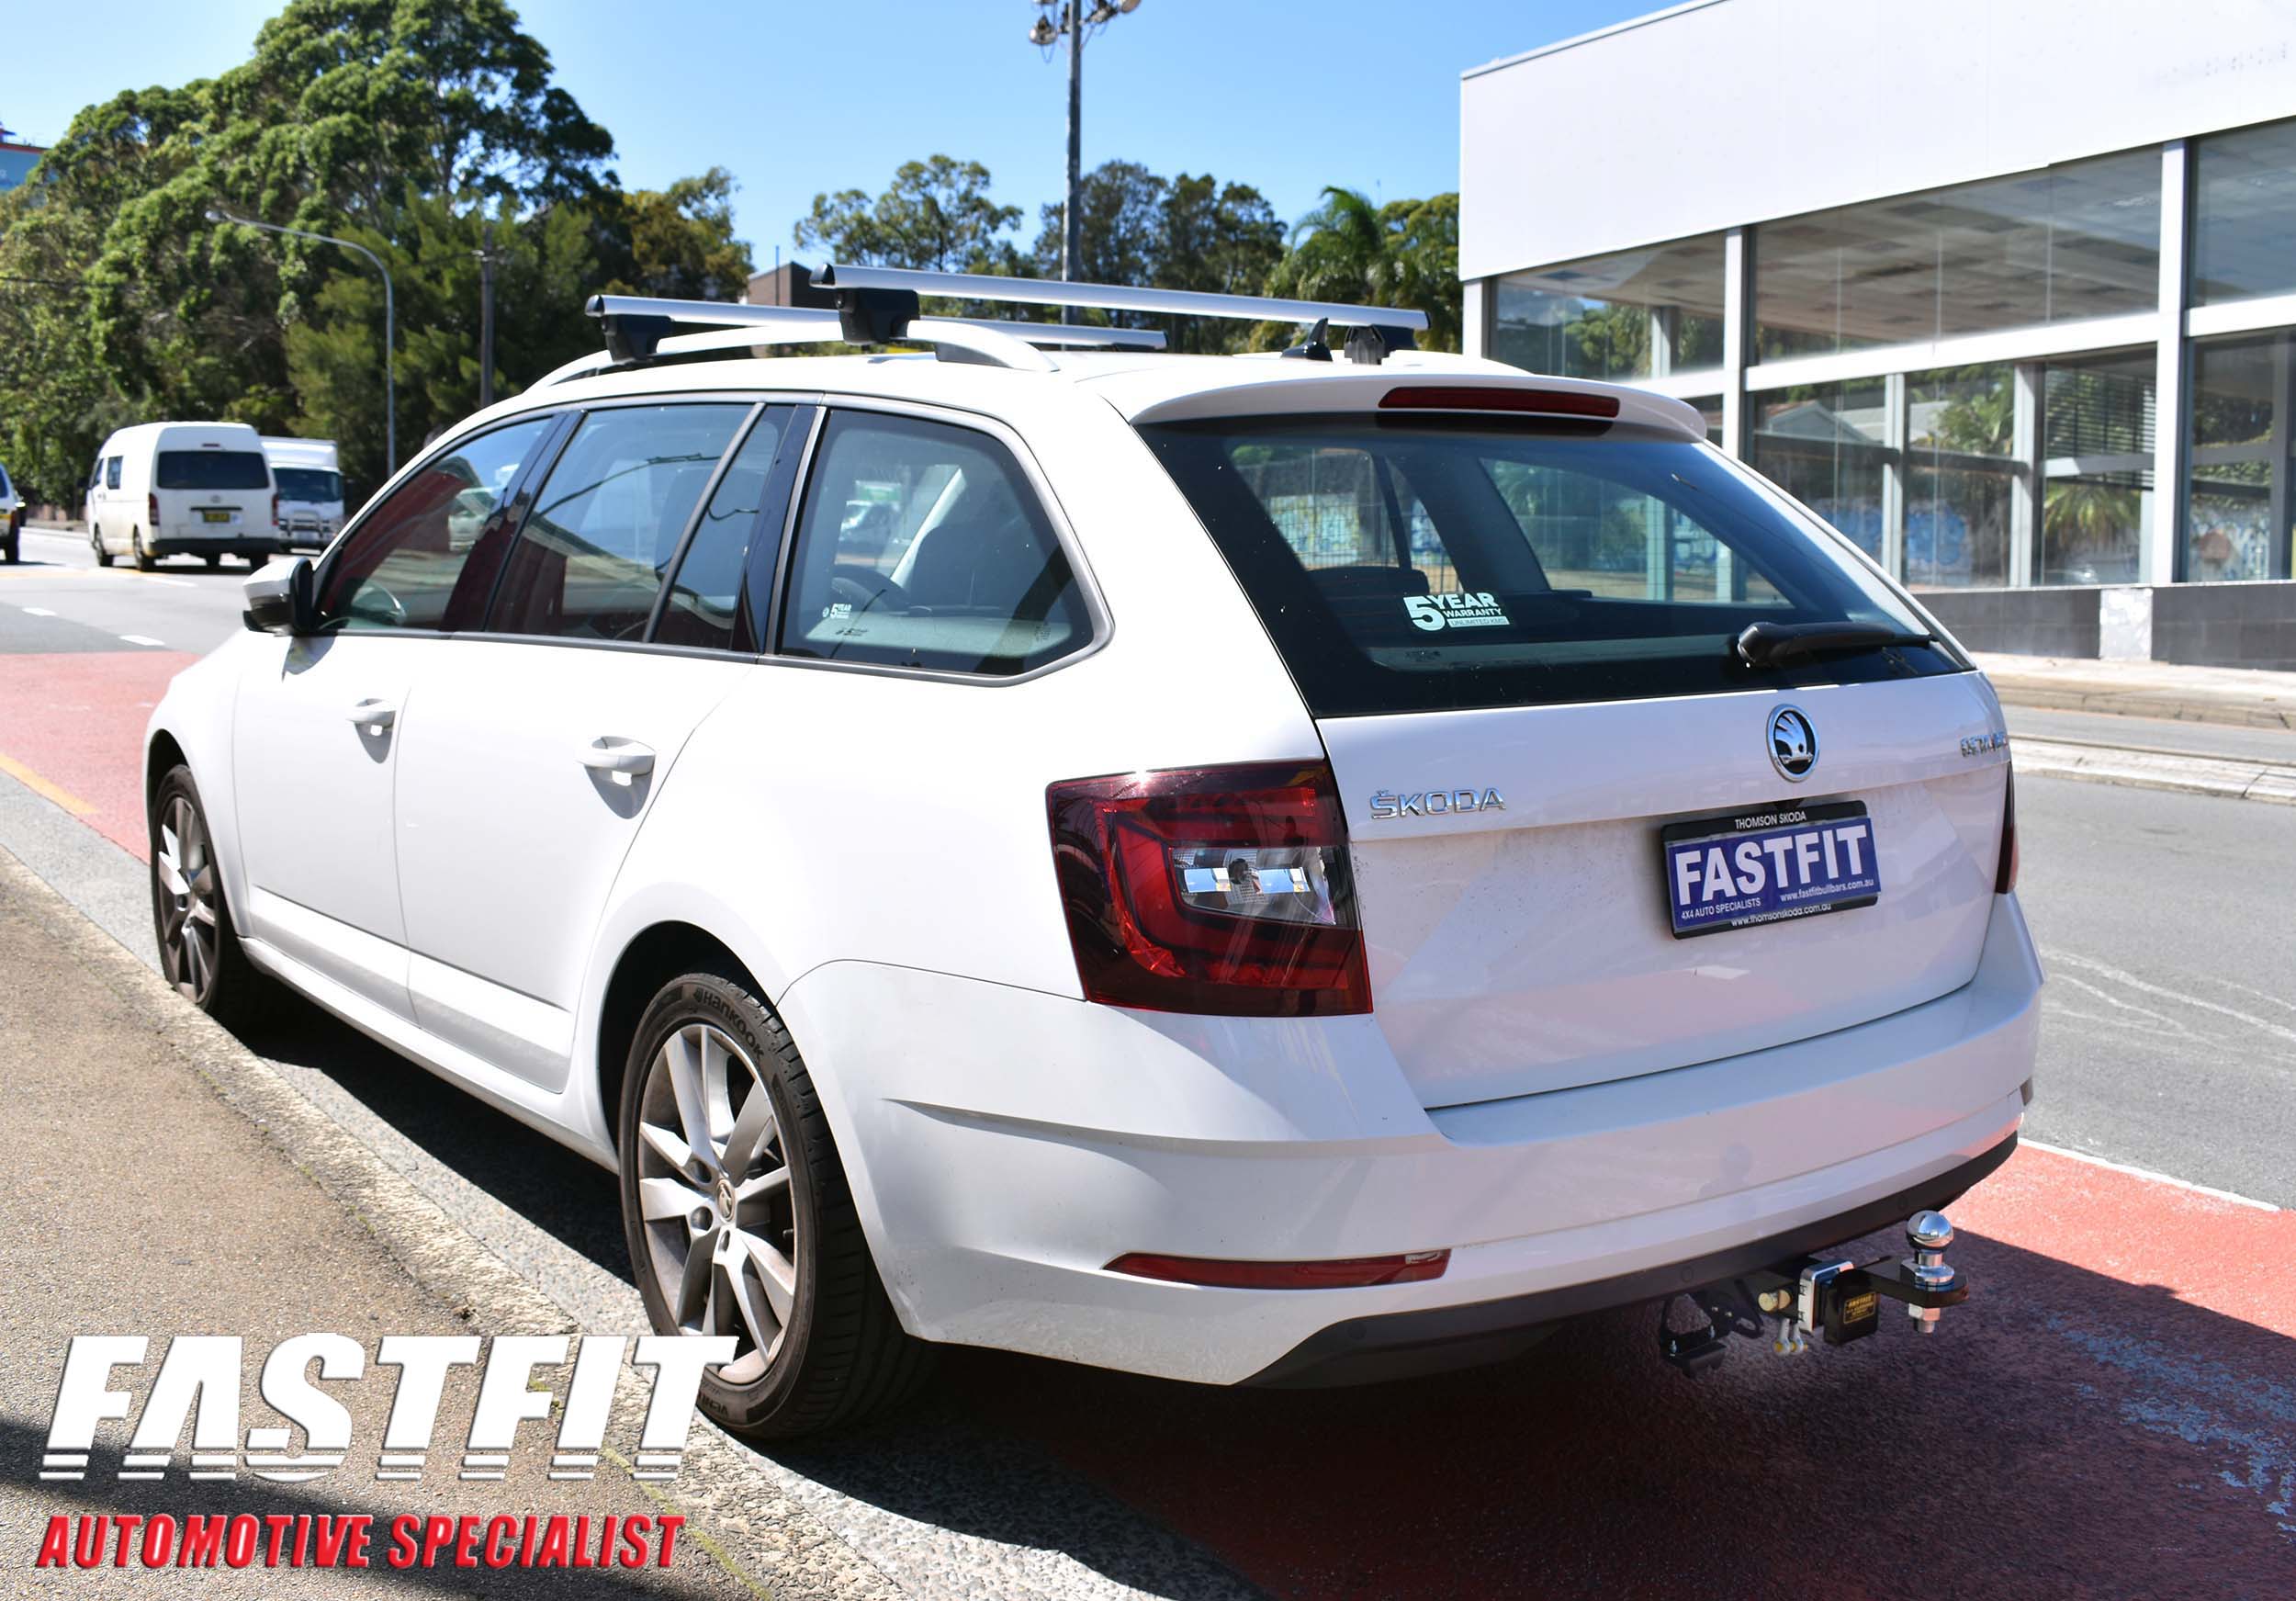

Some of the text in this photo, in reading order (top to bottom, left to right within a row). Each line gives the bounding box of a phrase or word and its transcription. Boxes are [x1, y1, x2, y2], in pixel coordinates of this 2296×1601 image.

[1403, 592, 1499, 631] 5 YEAR
[1443, 608, 1502, 618] WARRANTY
[1370, 787, 1507, 819] ŠKODA
[1735, 810, 1806, 829] THOMSON SKODA
[1675, 825, 1867, 906] FASTFIT
[1780, 879, 1874, 902] www.fastfitbullbars.com.au
[1694, 905, 1715, 919] AUTO
[1715, 897, 1761, 914] SPECIALISTS
[1731, 904, 1831, 927] www.thomsonskoda.com.au
